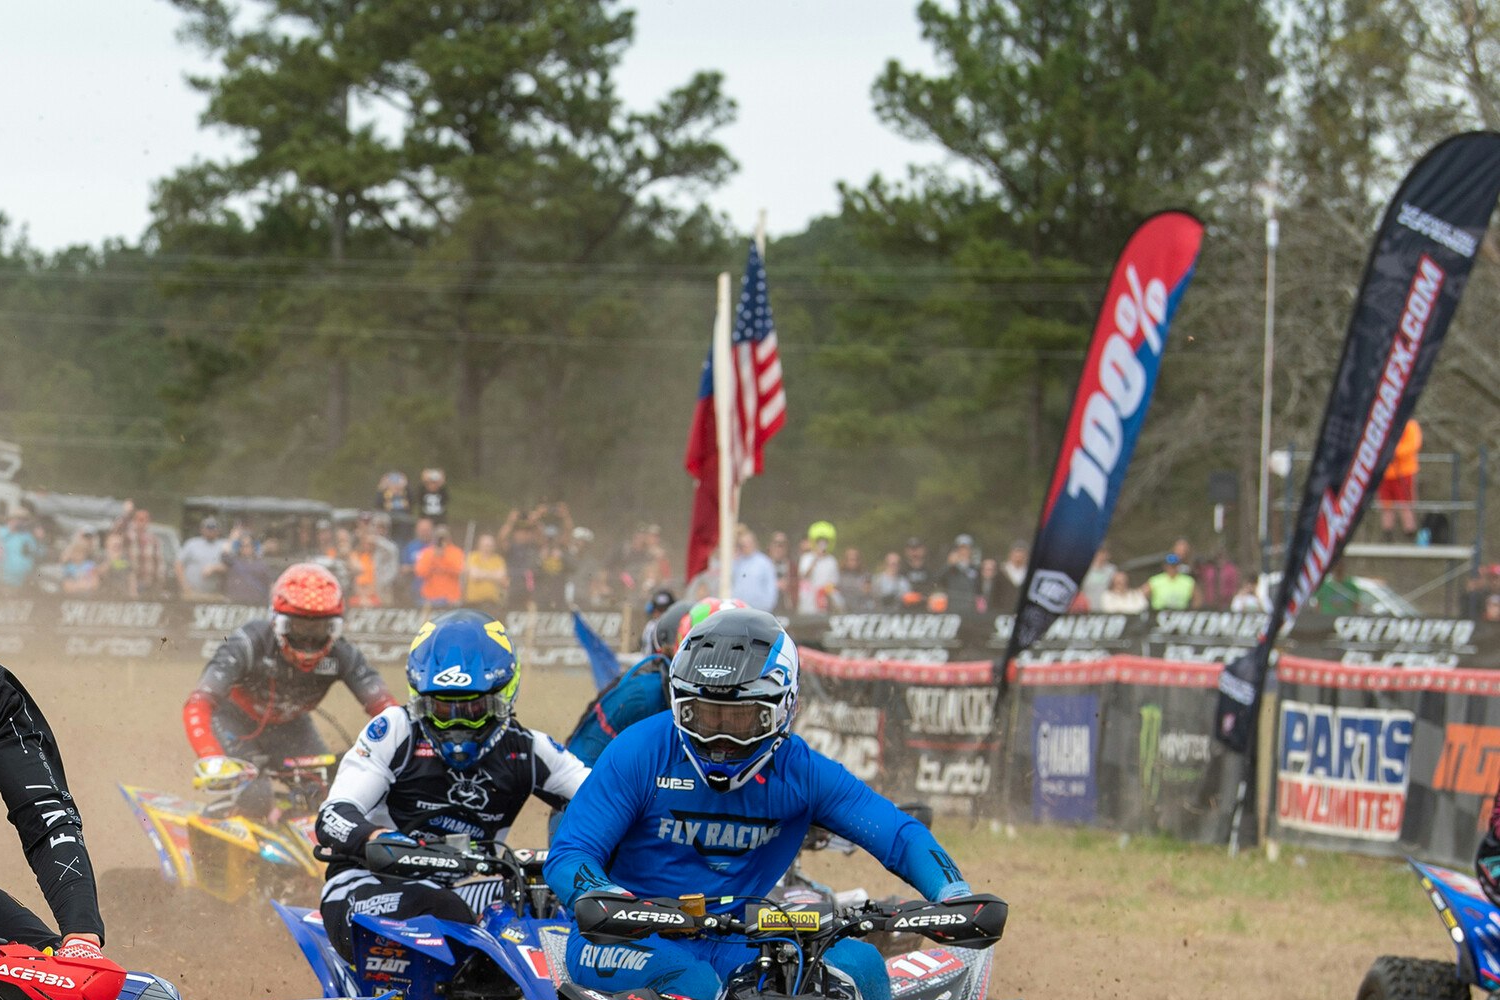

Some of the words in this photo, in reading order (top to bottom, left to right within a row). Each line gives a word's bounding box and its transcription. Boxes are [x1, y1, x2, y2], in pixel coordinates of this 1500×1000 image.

[1067, 261, 1171, 511] 100%
[828, 613, 962, 640] SPECIALIZED
[1334, 616, 1476, 646] SPECIALIZED
[1280, 707, 1414, 786] PARTS
[656, 776, 695, 791] WPS
[1278, 780, 1401, 835] UNLIMITED
[441, 816, 486, 840] YAMAHA
[658, 817, 700, 846] FLY
[398, 855, 460, 869] ACERBIS
[612, 909, 686, 925] ACERBIS
[893, 913, 968, 928] ACERBIS
[369, 946, 406, 957] CST
[579, 944, 603, 970] FLY
[598, 945, 654, 971] RACING
[891, 950, 944, 978] 11
